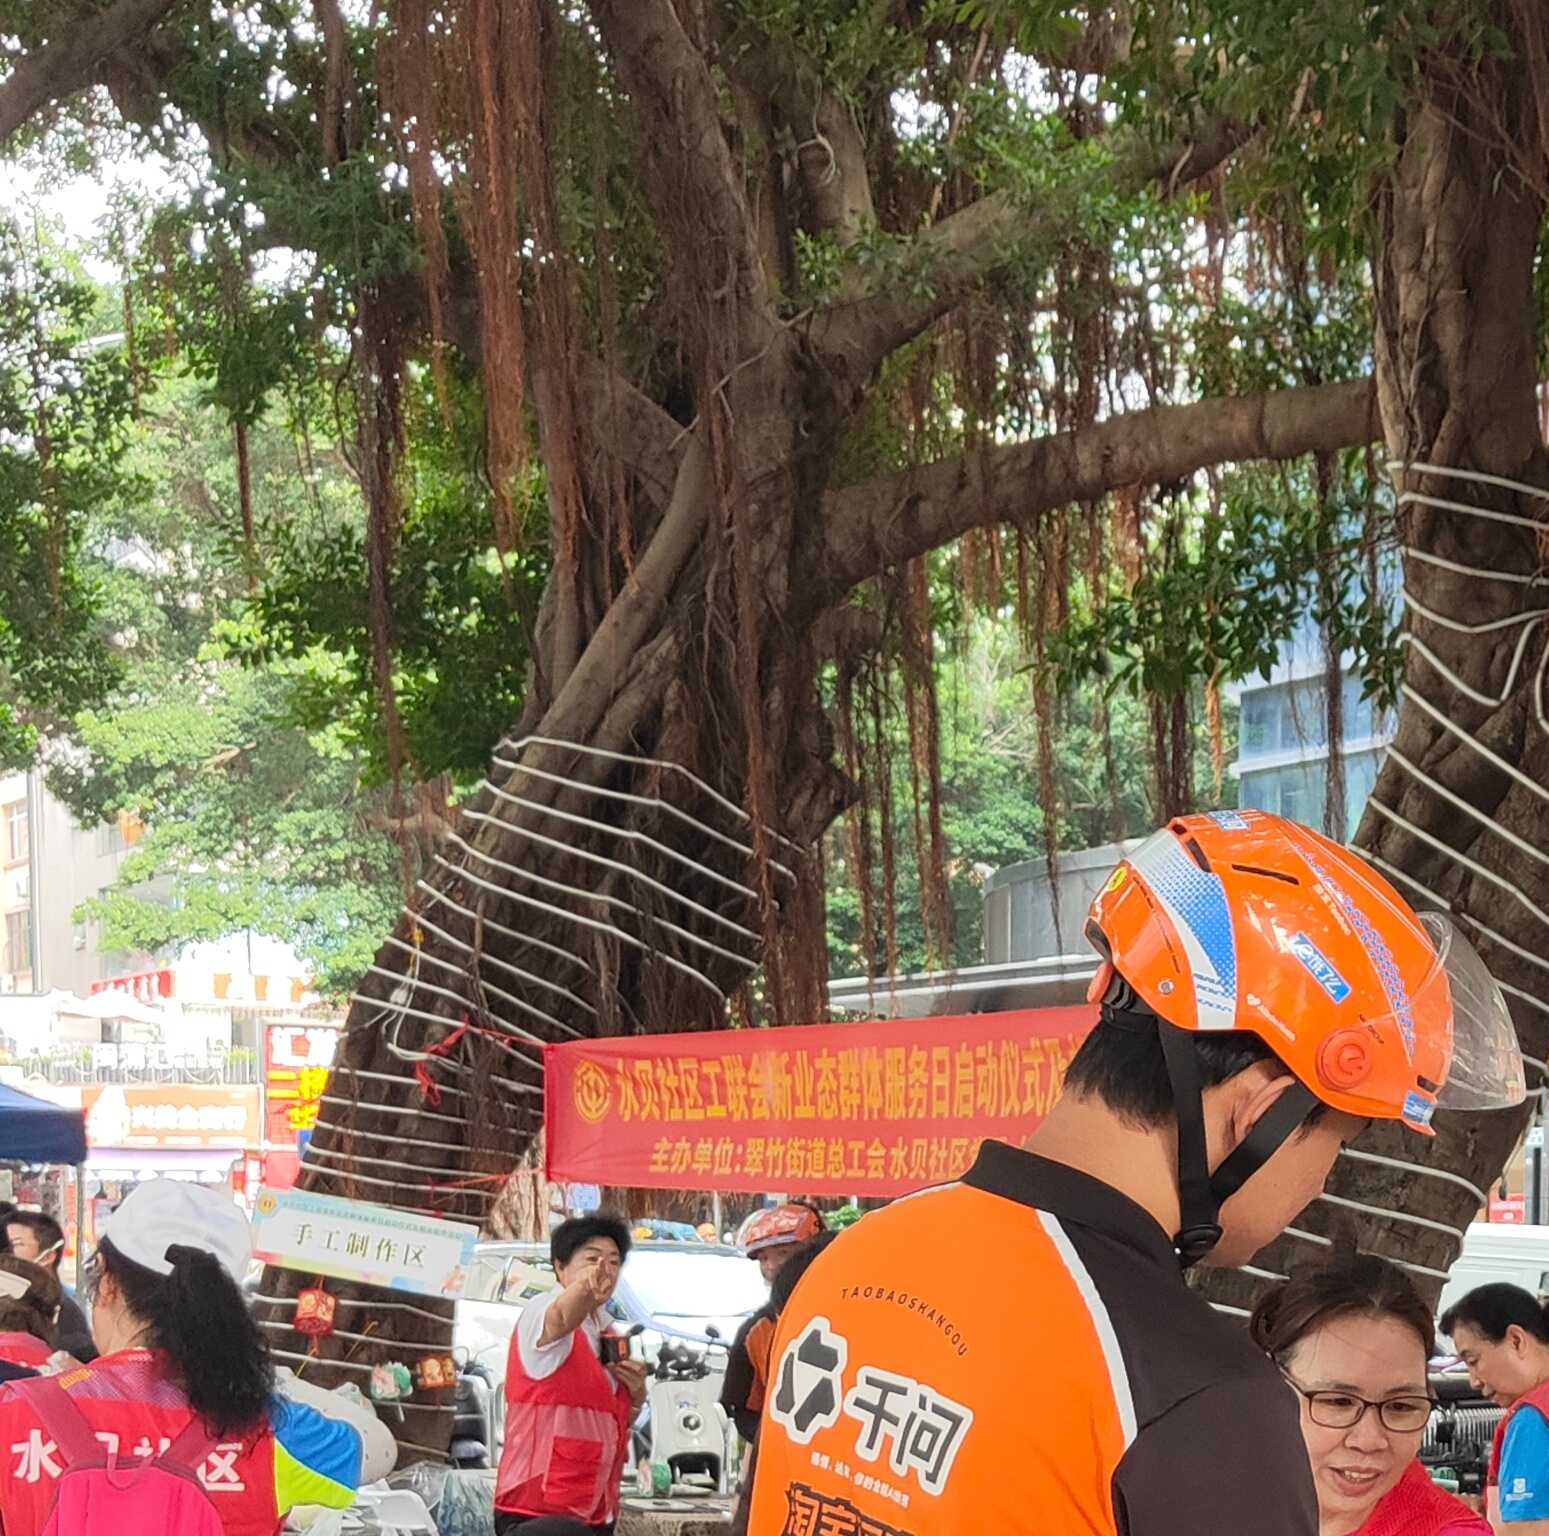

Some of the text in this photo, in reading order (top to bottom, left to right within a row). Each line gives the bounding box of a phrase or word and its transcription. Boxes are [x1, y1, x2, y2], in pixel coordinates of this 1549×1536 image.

[617, 1033, 1084, 1123] 水贝社区工联会新业态群体服务日启动仪式及
[649, 1134, 1020, 1182] 主办单位:翠竹街道总工会水贝社区
[292, 1222, 428, 1268] 手工制作区
[840, 1286, 968, 1357] TAOBAOSHANGOU
[11, 1428, 245, 1492] 水区
[849, 1371, 969, 1489] 千问
